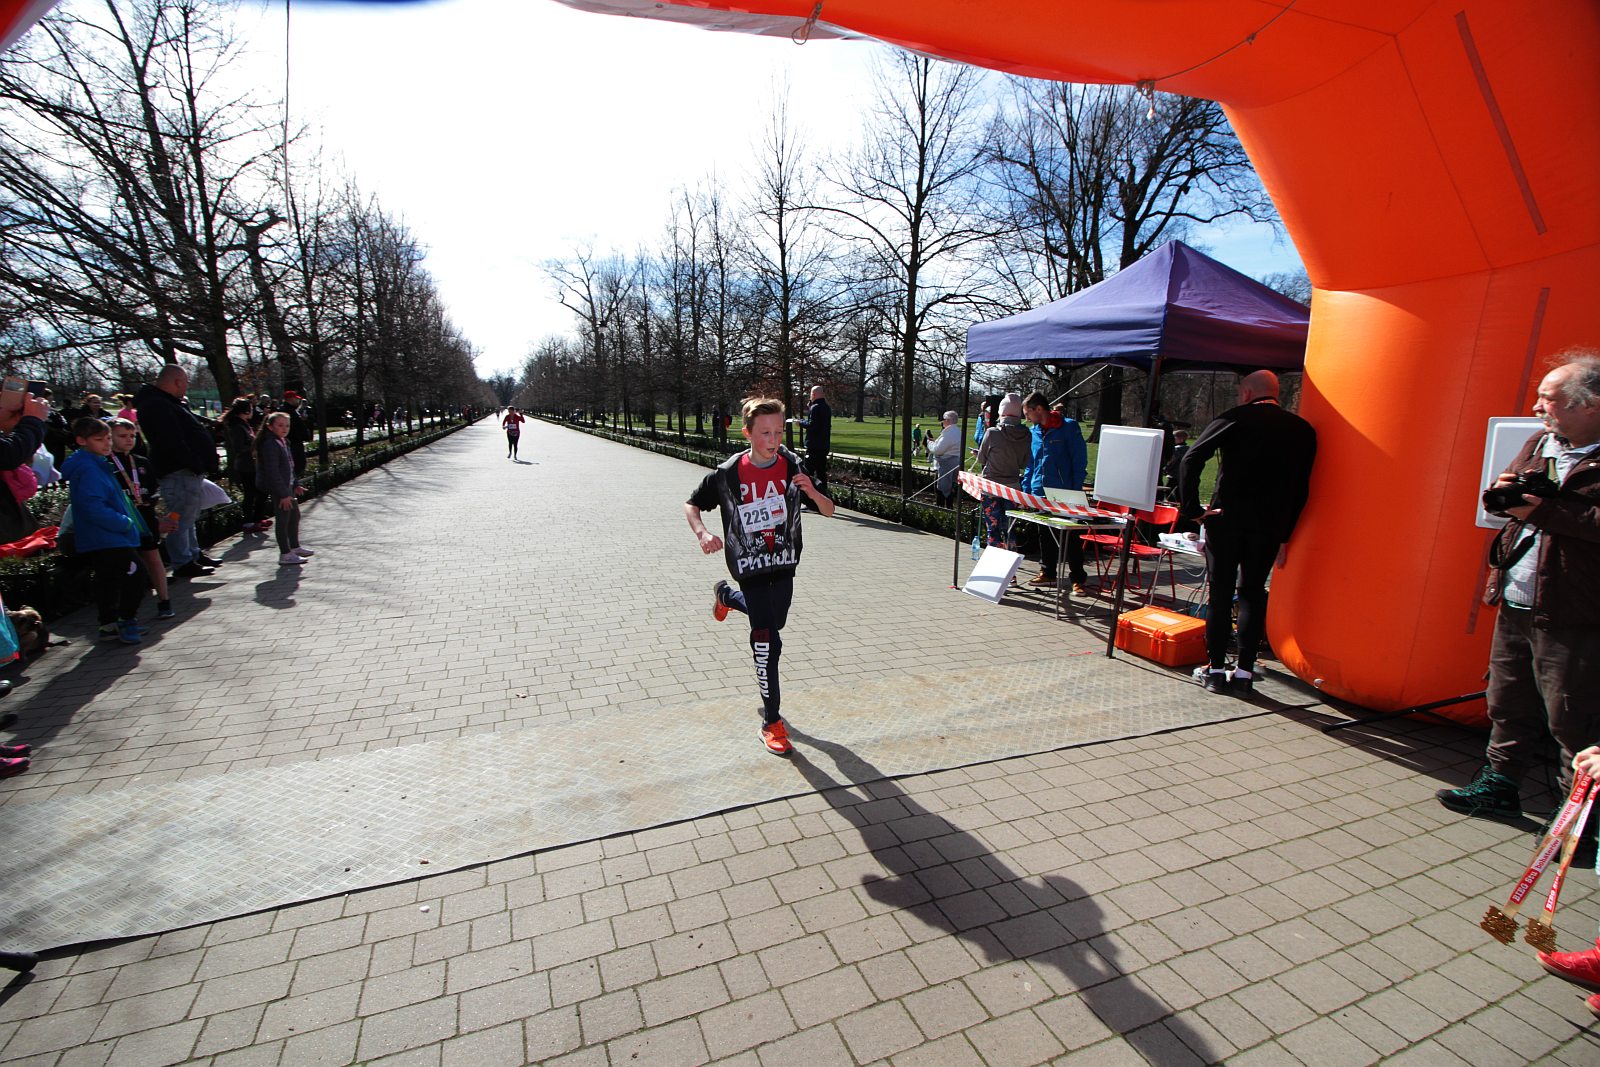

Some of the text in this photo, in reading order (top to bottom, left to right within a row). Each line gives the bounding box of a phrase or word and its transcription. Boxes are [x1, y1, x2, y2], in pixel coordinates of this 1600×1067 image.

[743, 508, 770, 526] 225
[1512, 881, 1528, 902] BIEG
[1526, 871, 1538, 883] Stu
